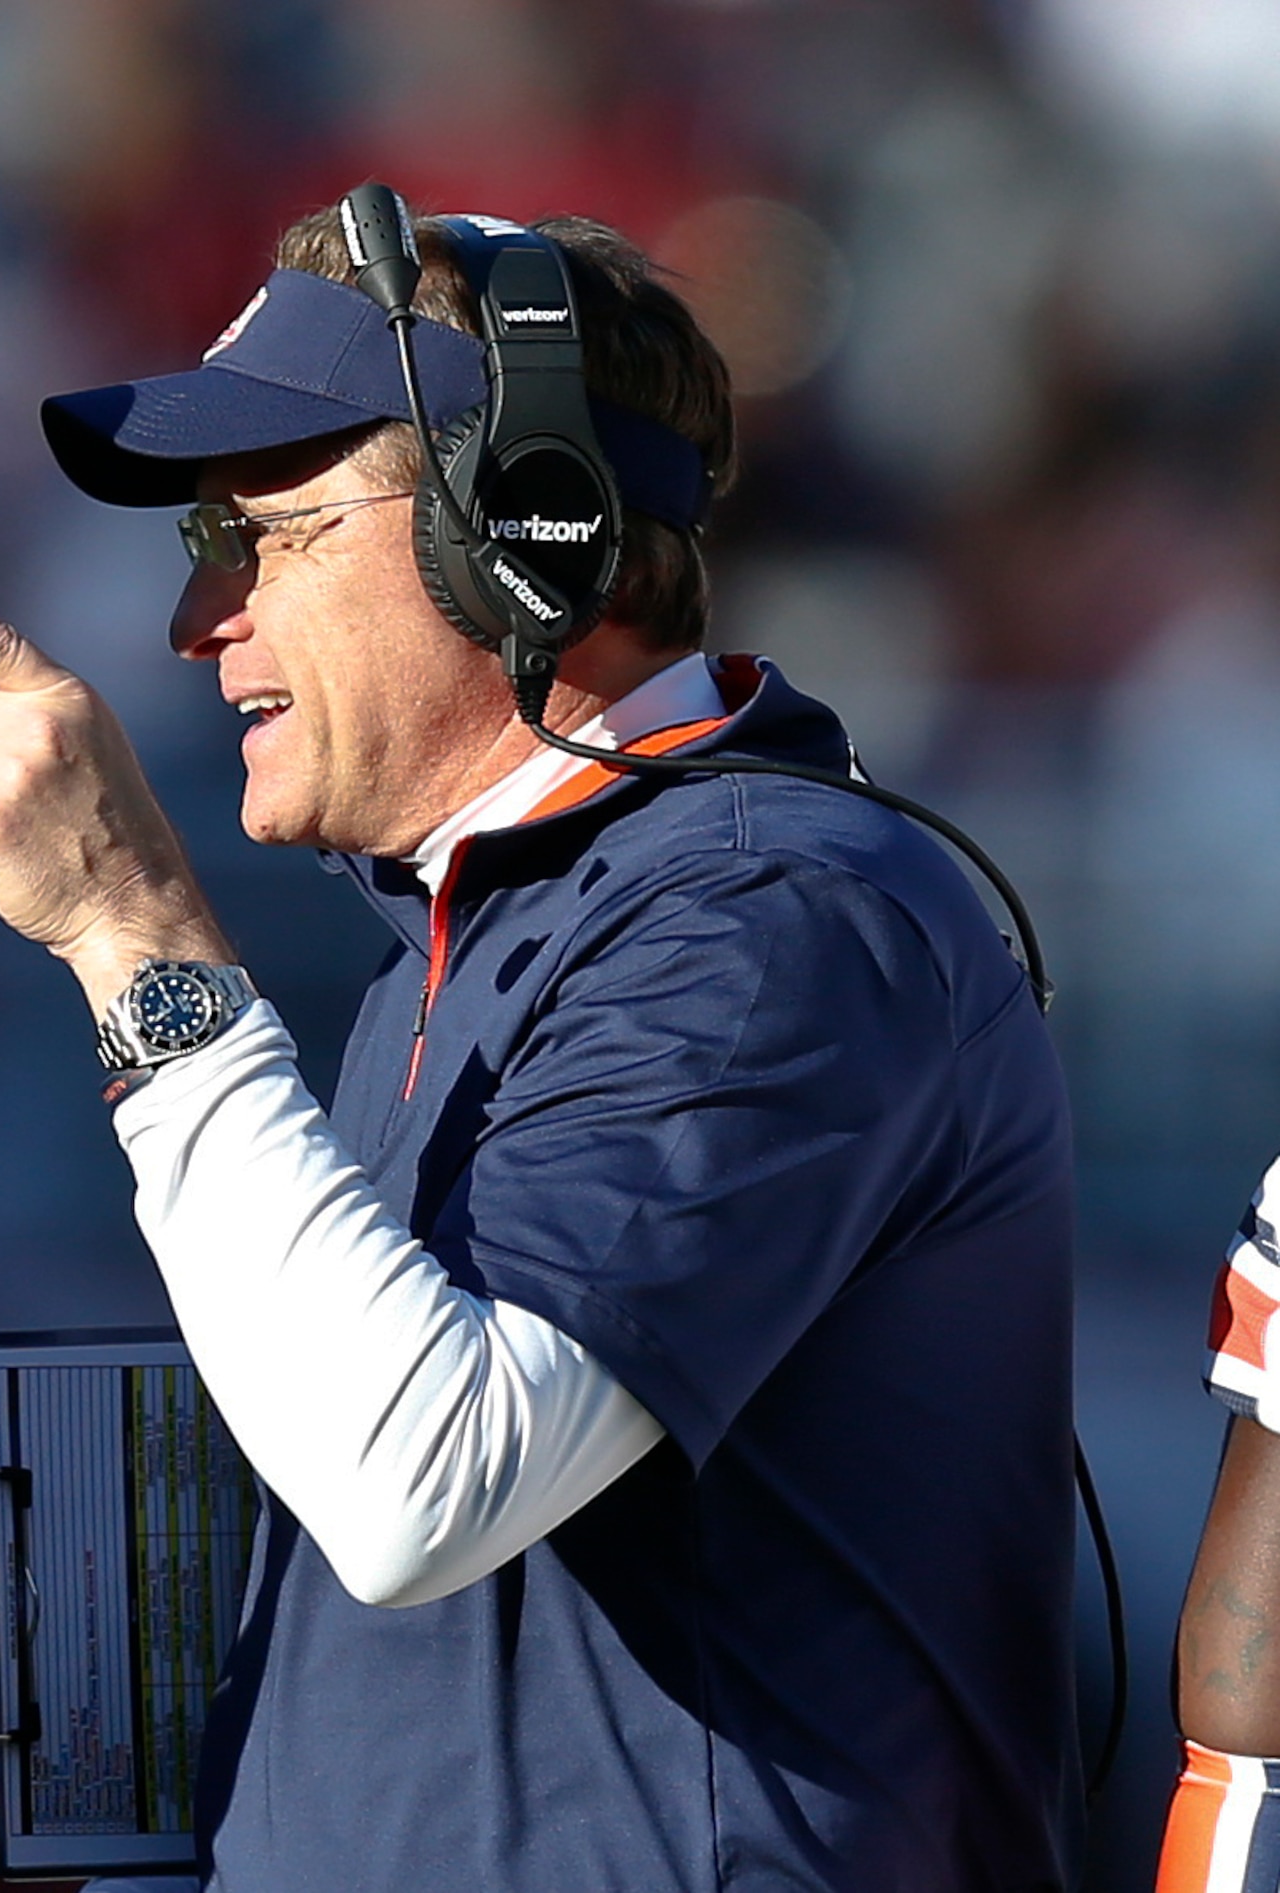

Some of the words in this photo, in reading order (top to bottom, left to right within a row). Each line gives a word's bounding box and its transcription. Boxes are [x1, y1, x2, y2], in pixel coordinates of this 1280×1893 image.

[502, 307, 567, 323] verizon
[488, 514, 600, 543] verizon
[492, 558, 562, 622] verizon
